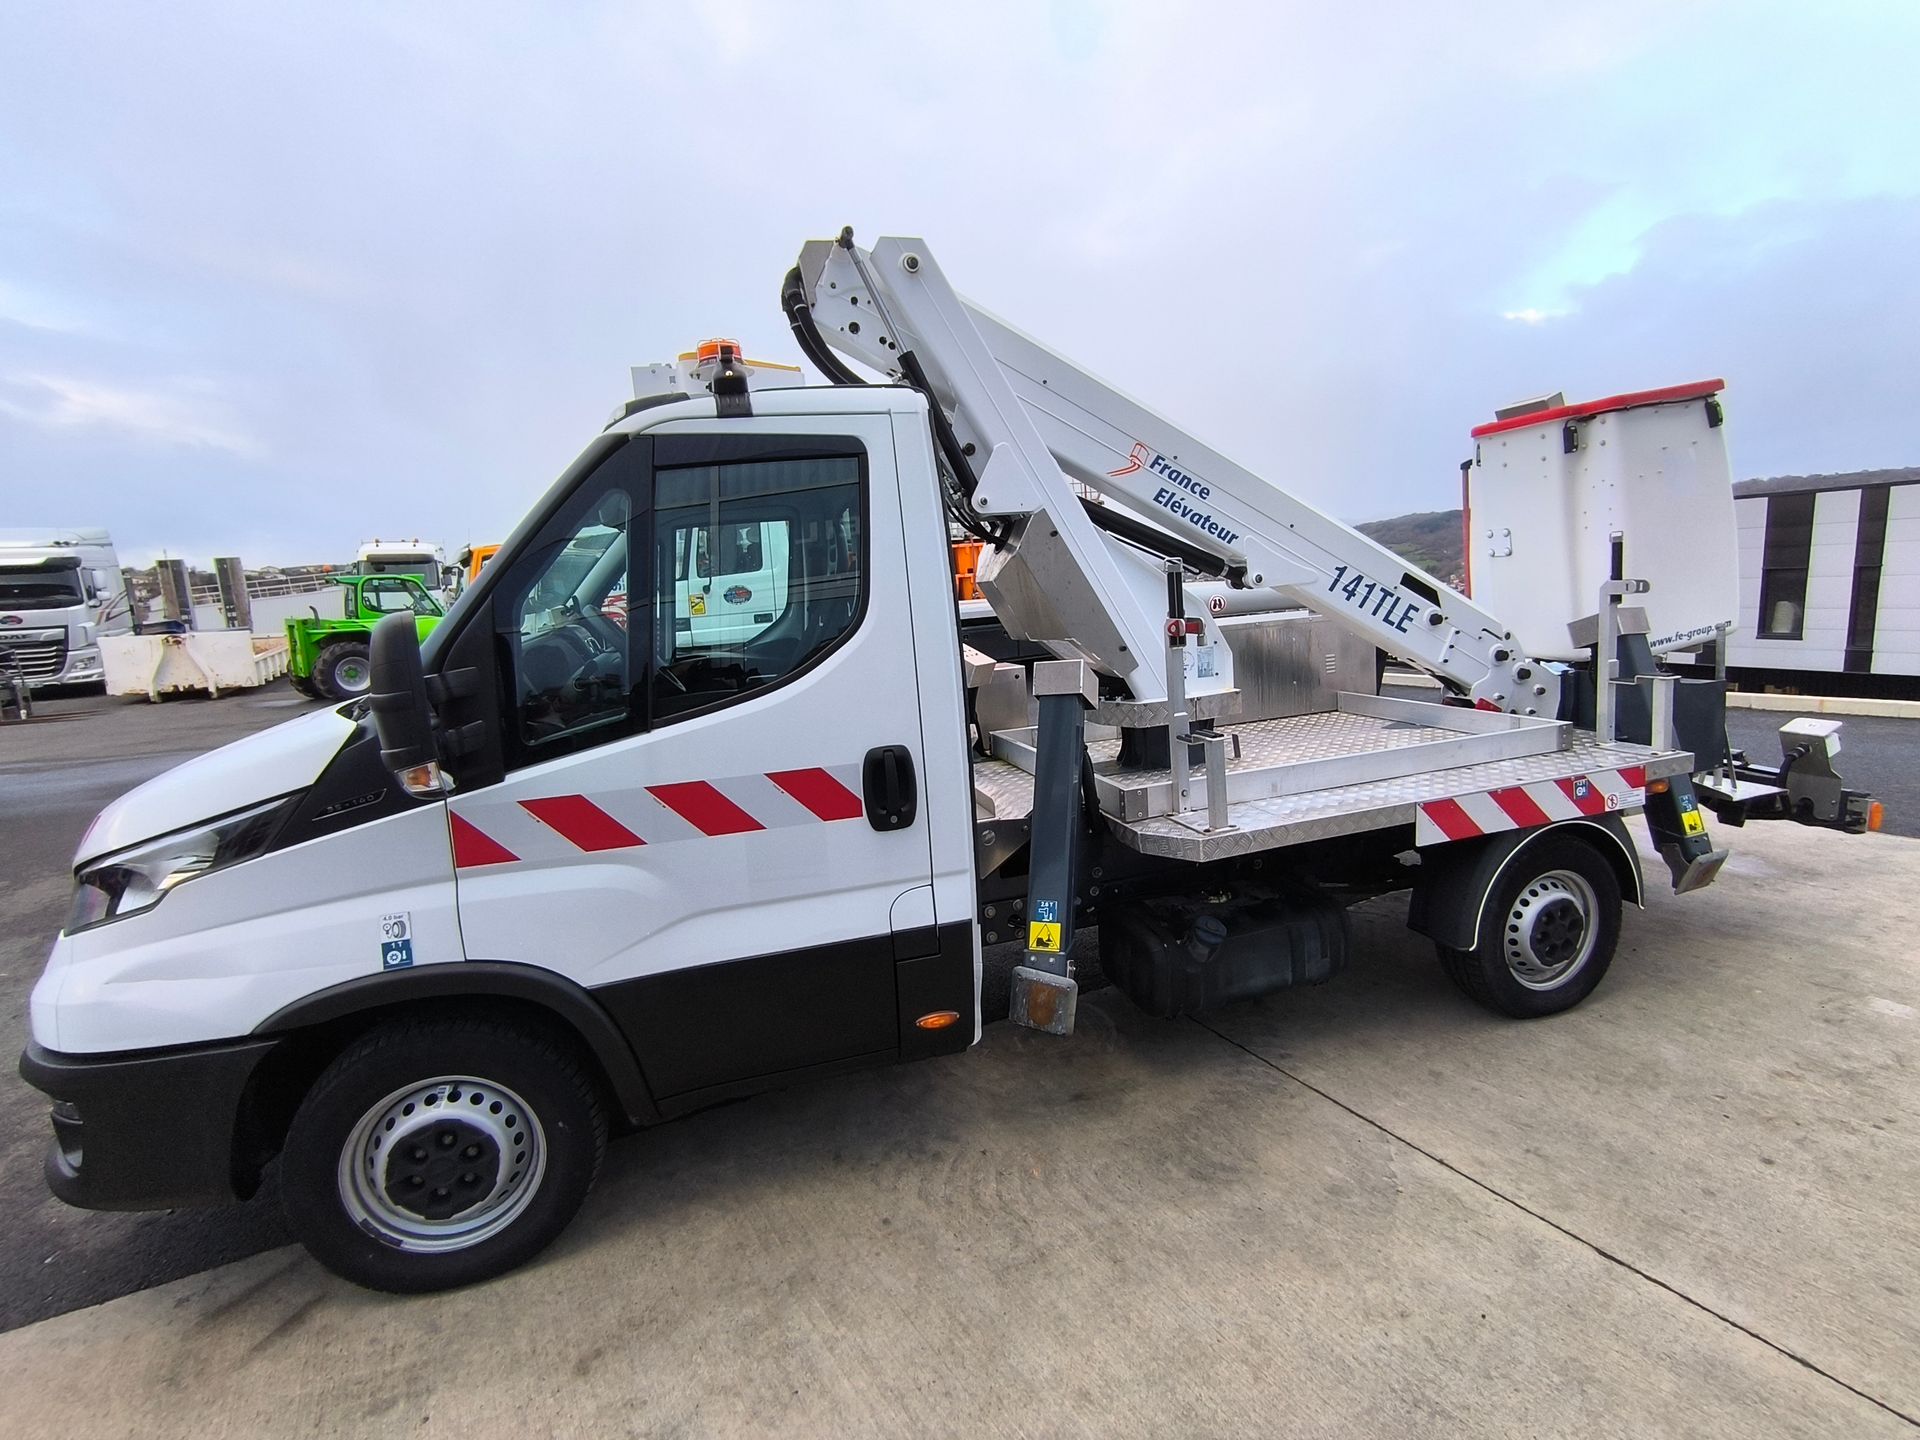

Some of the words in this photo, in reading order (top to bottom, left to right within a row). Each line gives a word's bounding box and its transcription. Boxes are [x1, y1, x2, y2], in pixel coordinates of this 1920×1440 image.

[1149, 454, 1210, 500] France
[1152, 487, 1239, 544] Elévateur
[1328, 565, 1420, 634] 141TLE
[1650, 620, 1732, 648] www.fe-group.m
